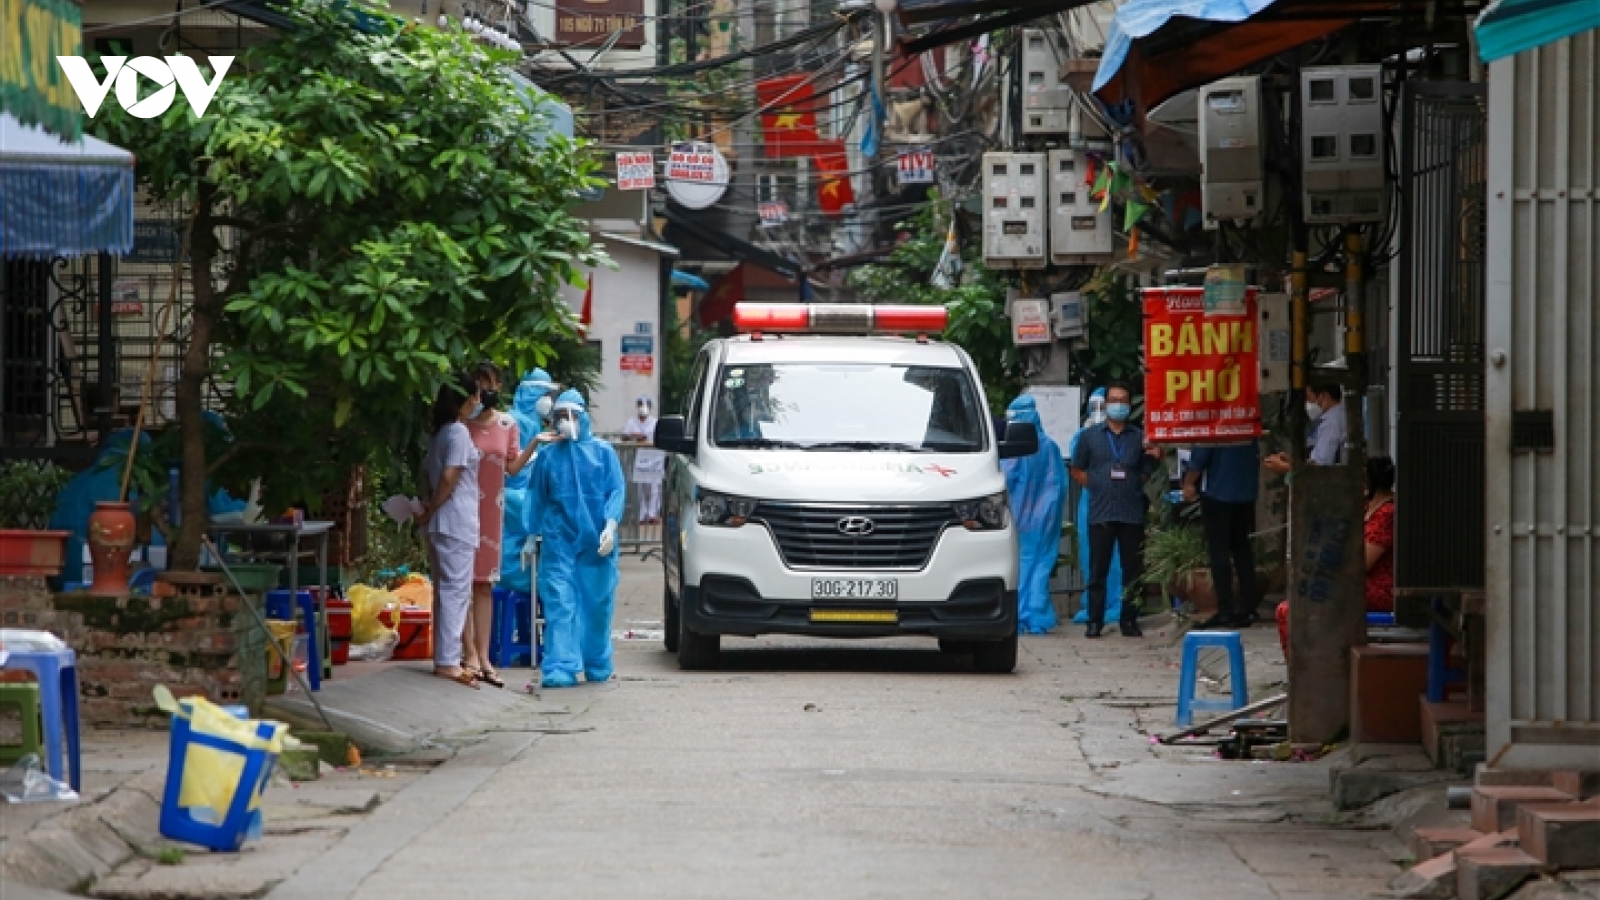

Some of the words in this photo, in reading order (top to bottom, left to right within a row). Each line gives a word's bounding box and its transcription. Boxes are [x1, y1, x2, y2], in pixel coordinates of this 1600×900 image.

[1150, 315, 1253, 357] BÁNH
[1165, 357, 1241, 404] PHỞ
[814, 580, 894, 597] 30G-217.30
